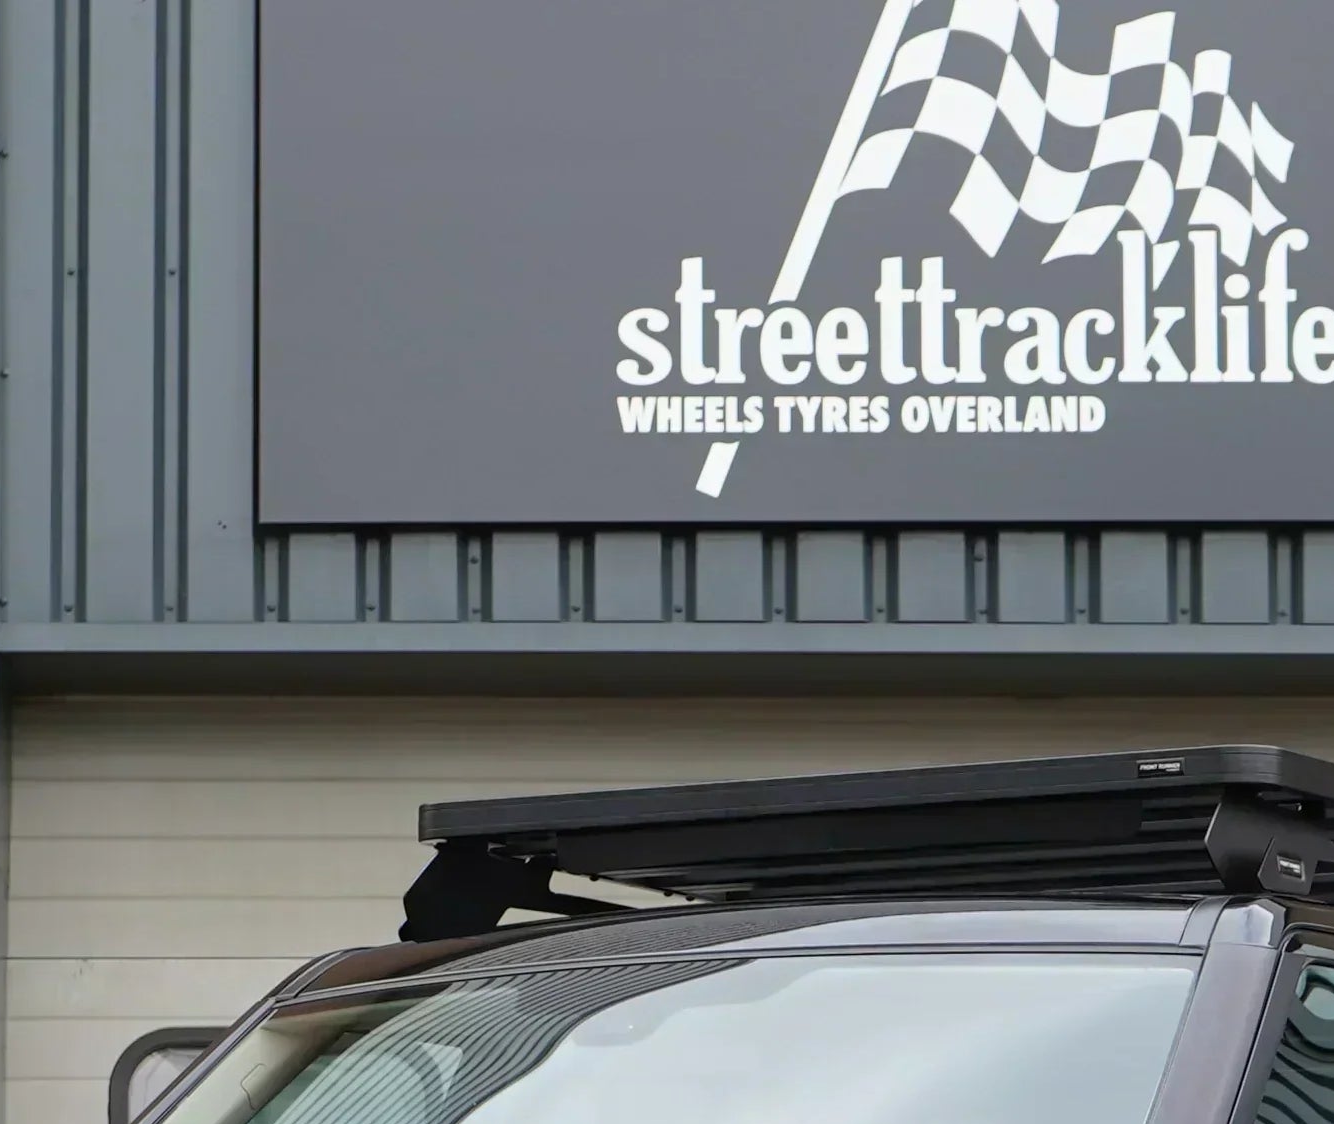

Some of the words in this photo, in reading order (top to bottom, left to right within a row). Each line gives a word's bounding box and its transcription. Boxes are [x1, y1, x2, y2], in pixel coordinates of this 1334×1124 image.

[616, 395, 765, 434] WHEELS
[773, 395, 890, 434] TYRES
[900, 395, 1106, 434] OVERLAND
